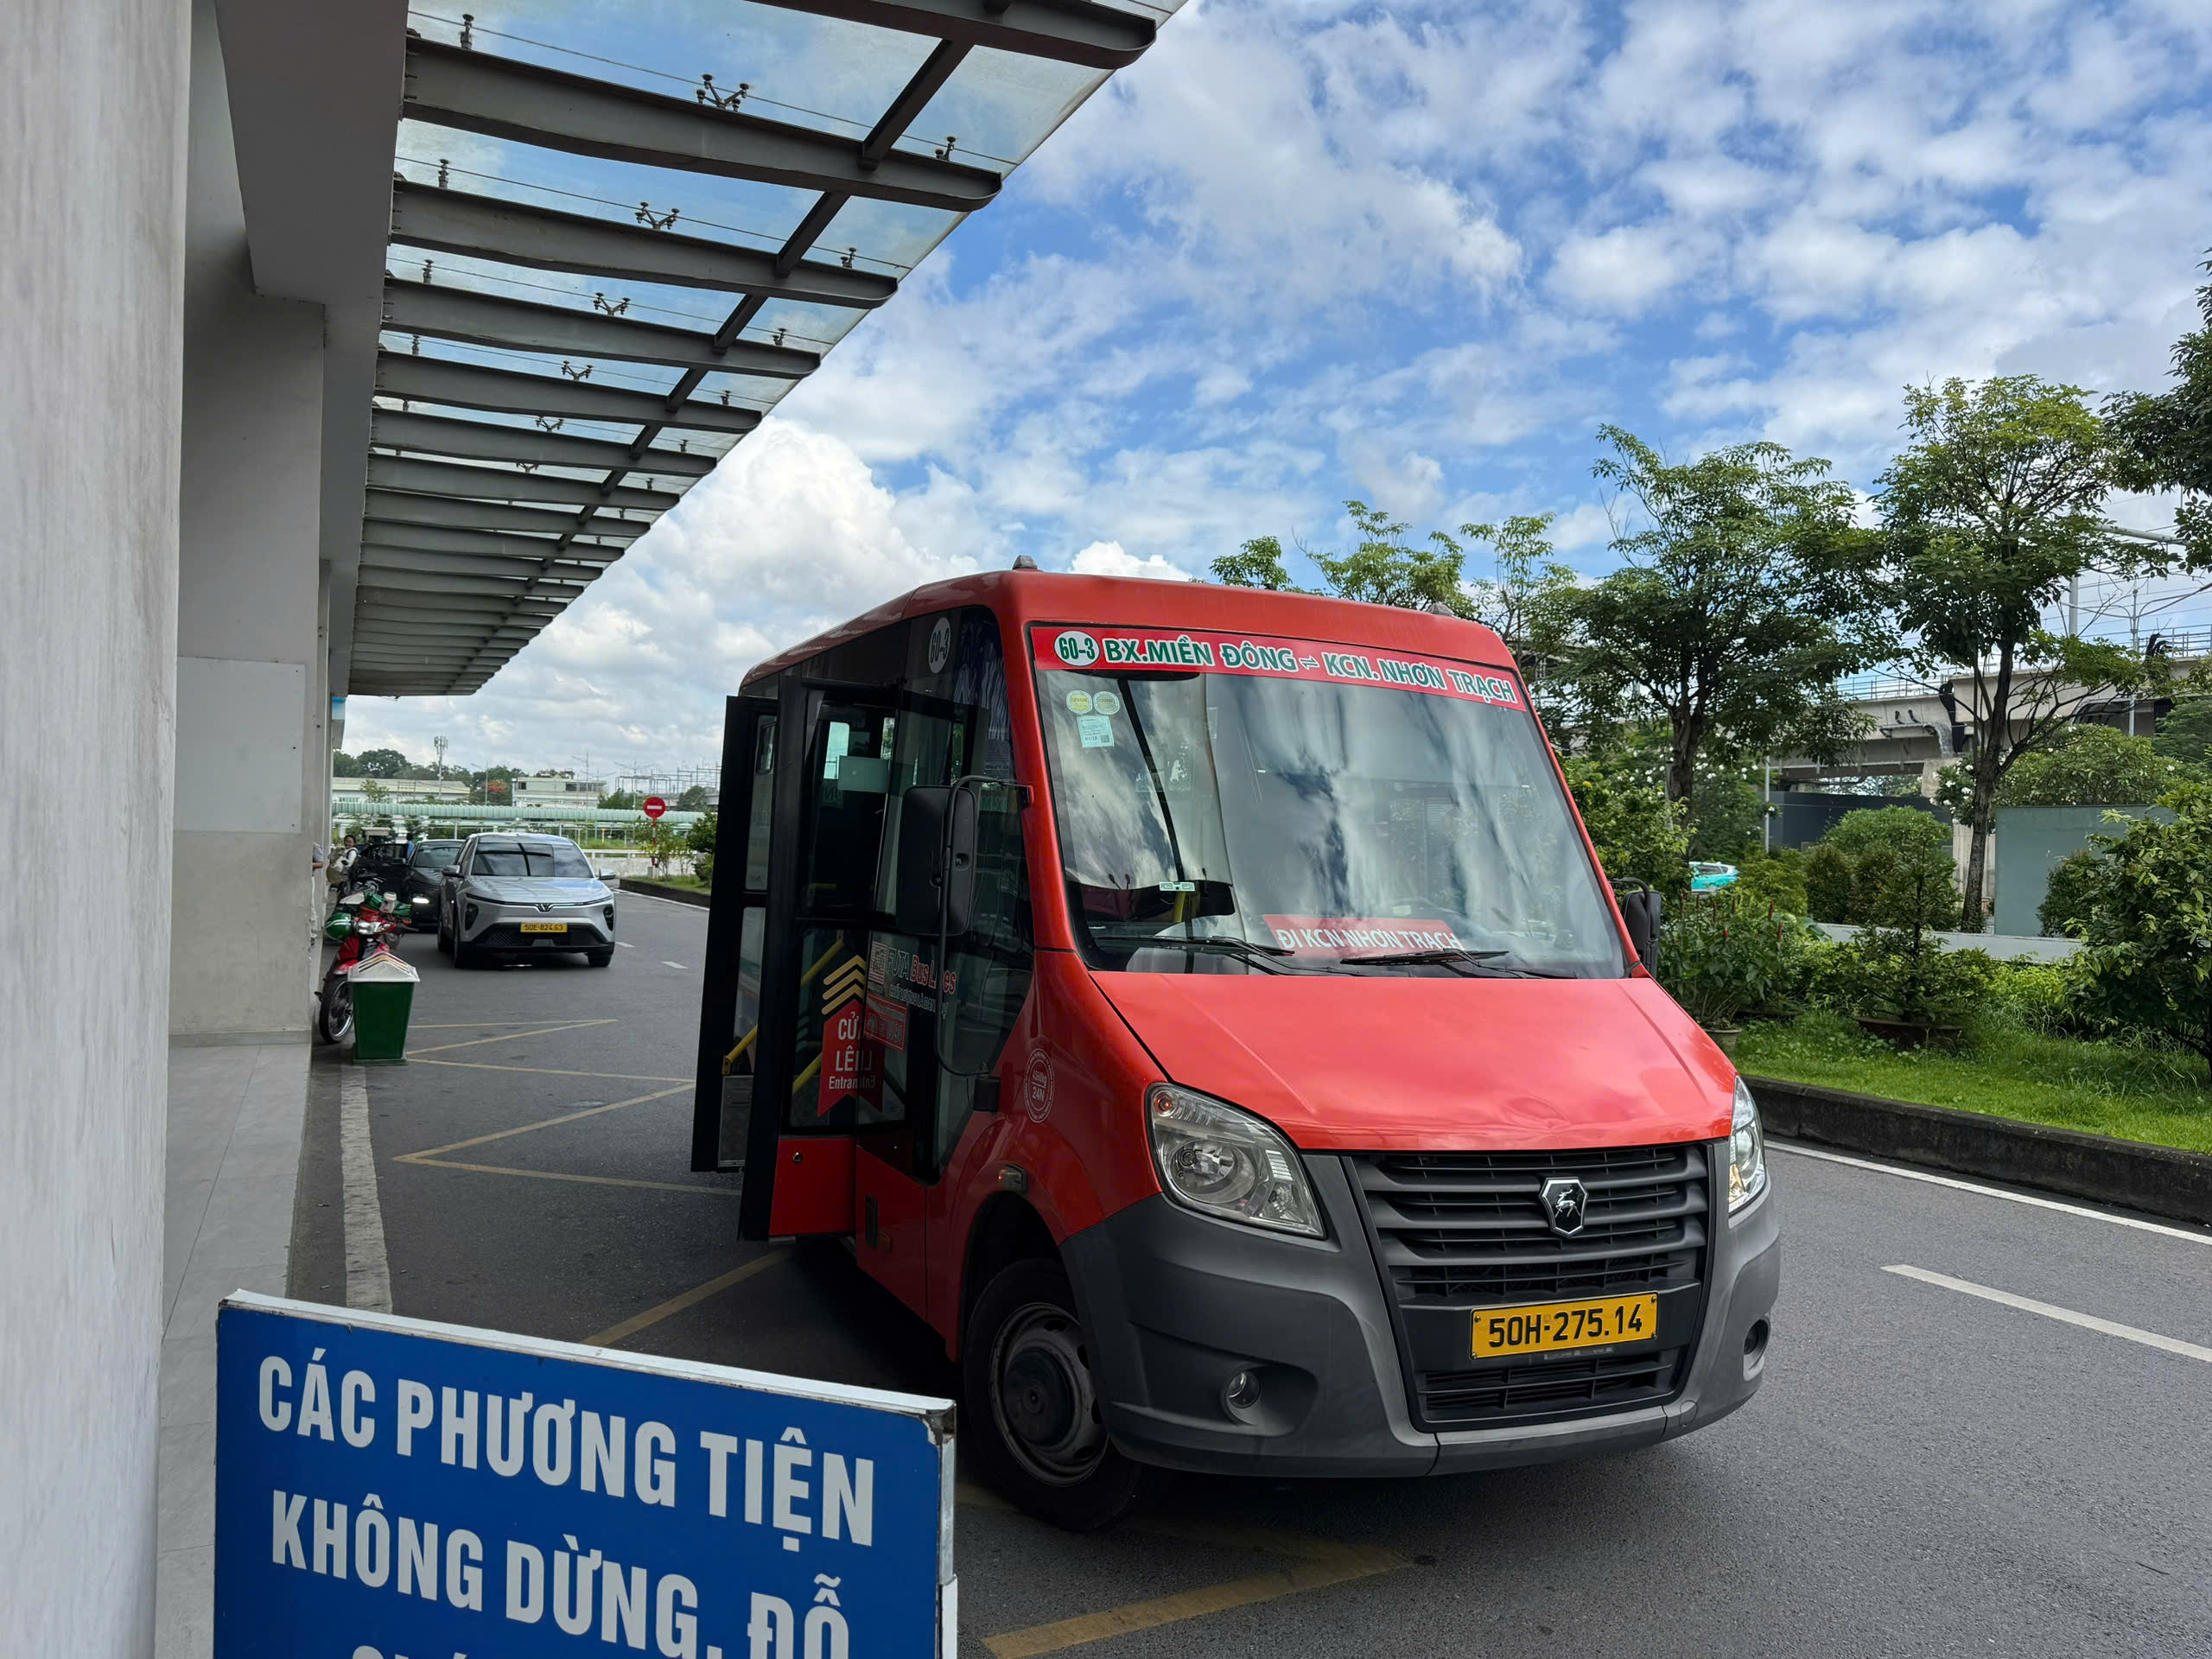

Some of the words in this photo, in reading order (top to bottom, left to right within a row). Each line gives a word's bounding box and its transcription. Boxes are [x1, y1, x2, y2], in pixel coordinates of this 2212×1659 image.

[1058, 637, 1096, 660] 60-3
[1103, 635, 1214, 666] BX.MIỀN
[1220, 640, 1298, 672] ĐÔNG
[1378, 659, 1446, 690] NHƠN
[1447, 669, 1517, 703] TRẠCH
[1275, 928, 1303, 949] ĐI
[1300, 929, 1345, 948] KCN
[1341, 928, 1403, 948] NHƠN
[910, 954, 929, 987] Bus
[1489, 1304, 1642, 1348] 50H-275.14
[259, 1347, 376, 1448] CÁC
[397, 1378, 676, 1508] PHƯƠNG
[700, 1427, 874, 1553] TIỆN
[272, 1490, 483, 1611] KHÔNG
[747, 1573, 849, 1659] ĐỖ
